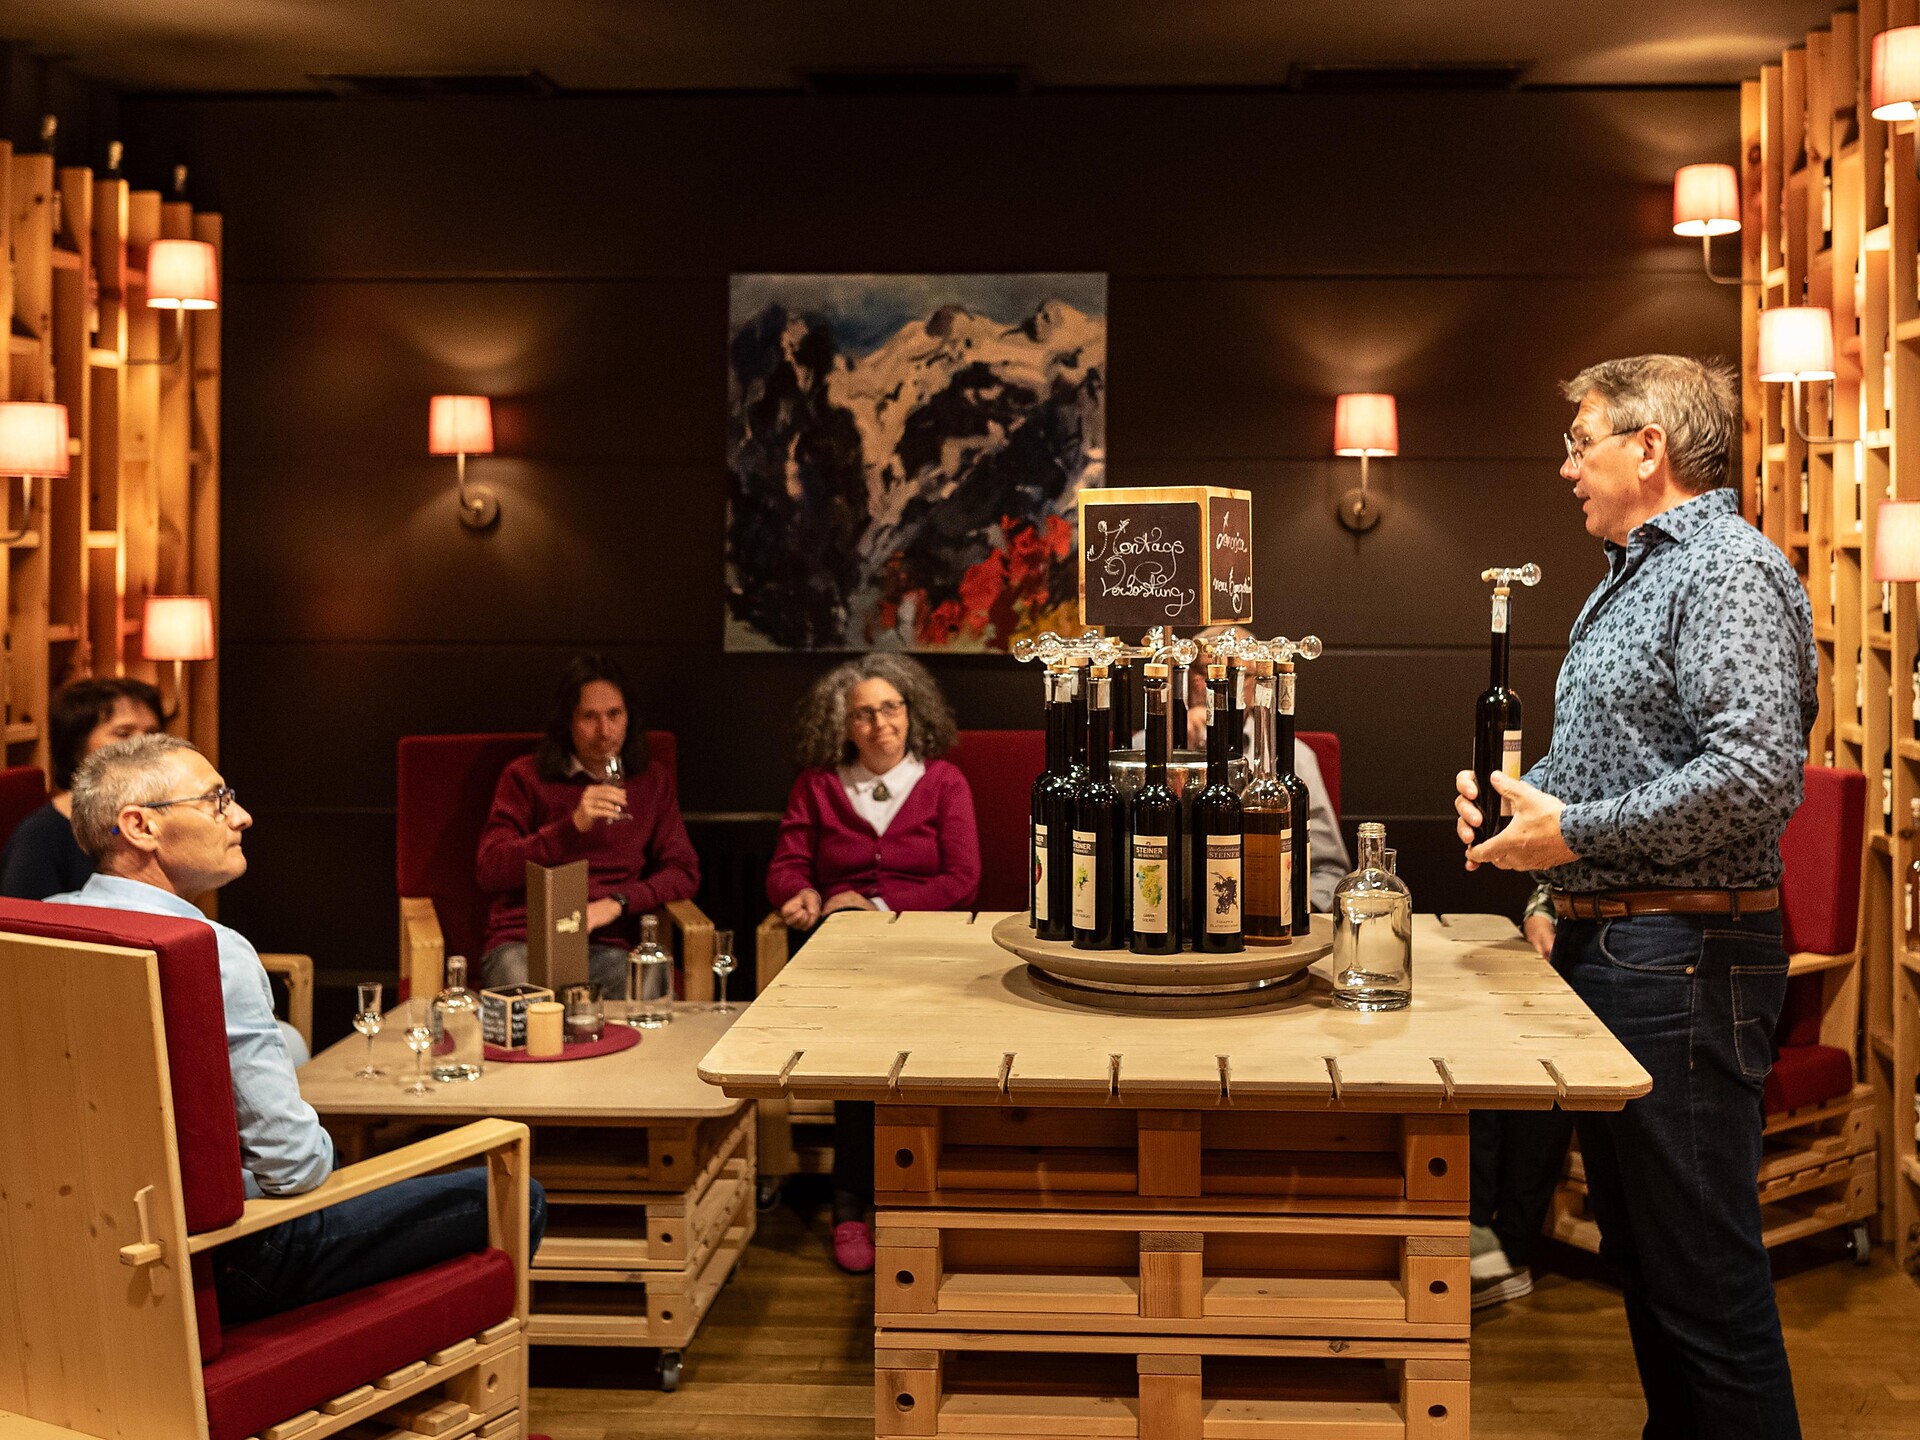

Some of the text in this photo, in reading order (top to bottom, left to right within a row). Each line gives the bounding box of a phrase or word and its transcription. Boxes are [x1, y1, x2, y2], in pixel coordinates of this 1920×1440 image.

[1087, 518, 1185, 567] Montags
[1072, 841, 1092, 850] TEINER
[1135, 846, 1163, 854] STEINER
